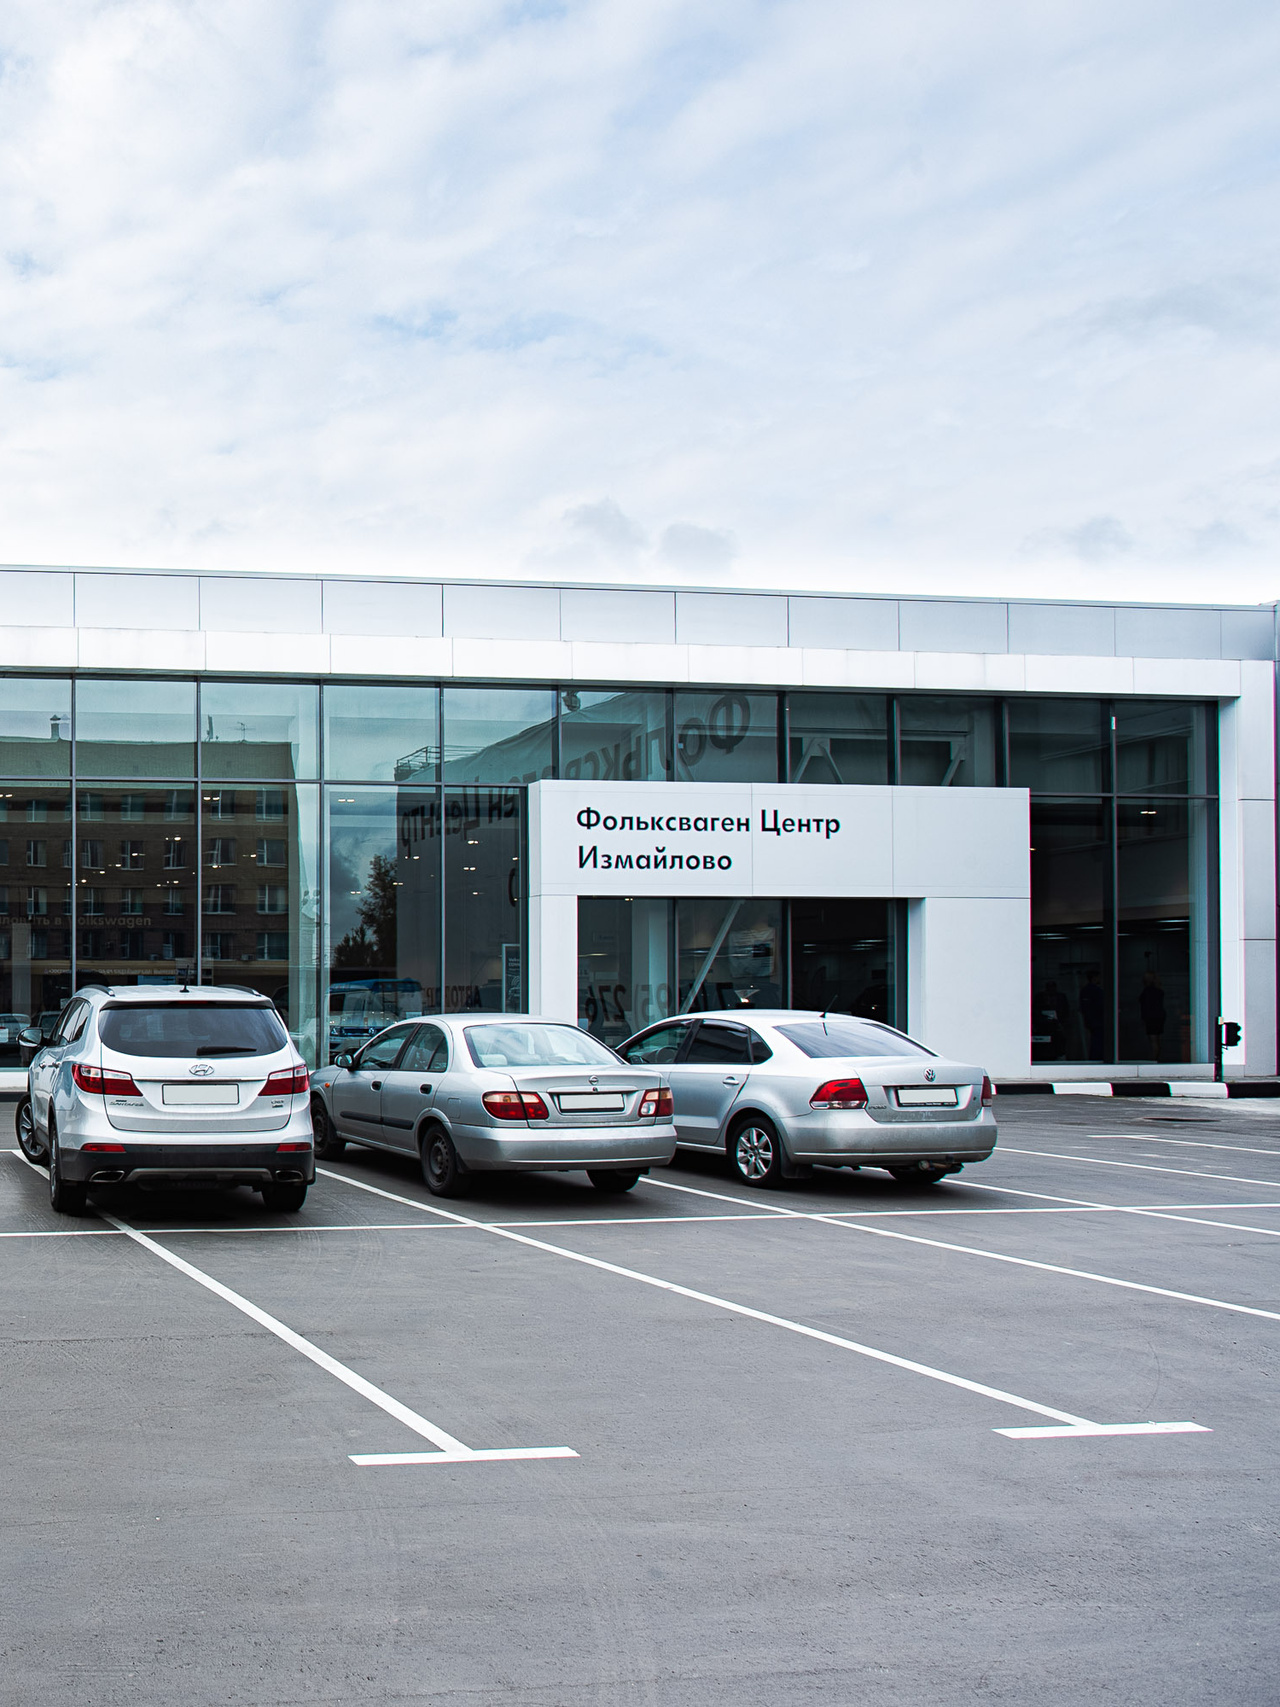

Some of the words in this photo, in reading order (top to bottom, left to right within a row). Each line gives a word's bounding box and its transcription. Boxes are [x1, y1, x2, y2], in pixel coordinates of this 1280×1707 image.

[576, 806, 750, 832] Фольксваген
[760, 809, 841, 839] Центр
[578, 845, 732, 870] Измайлово
[68, 914, 152, 928] olkswagen
